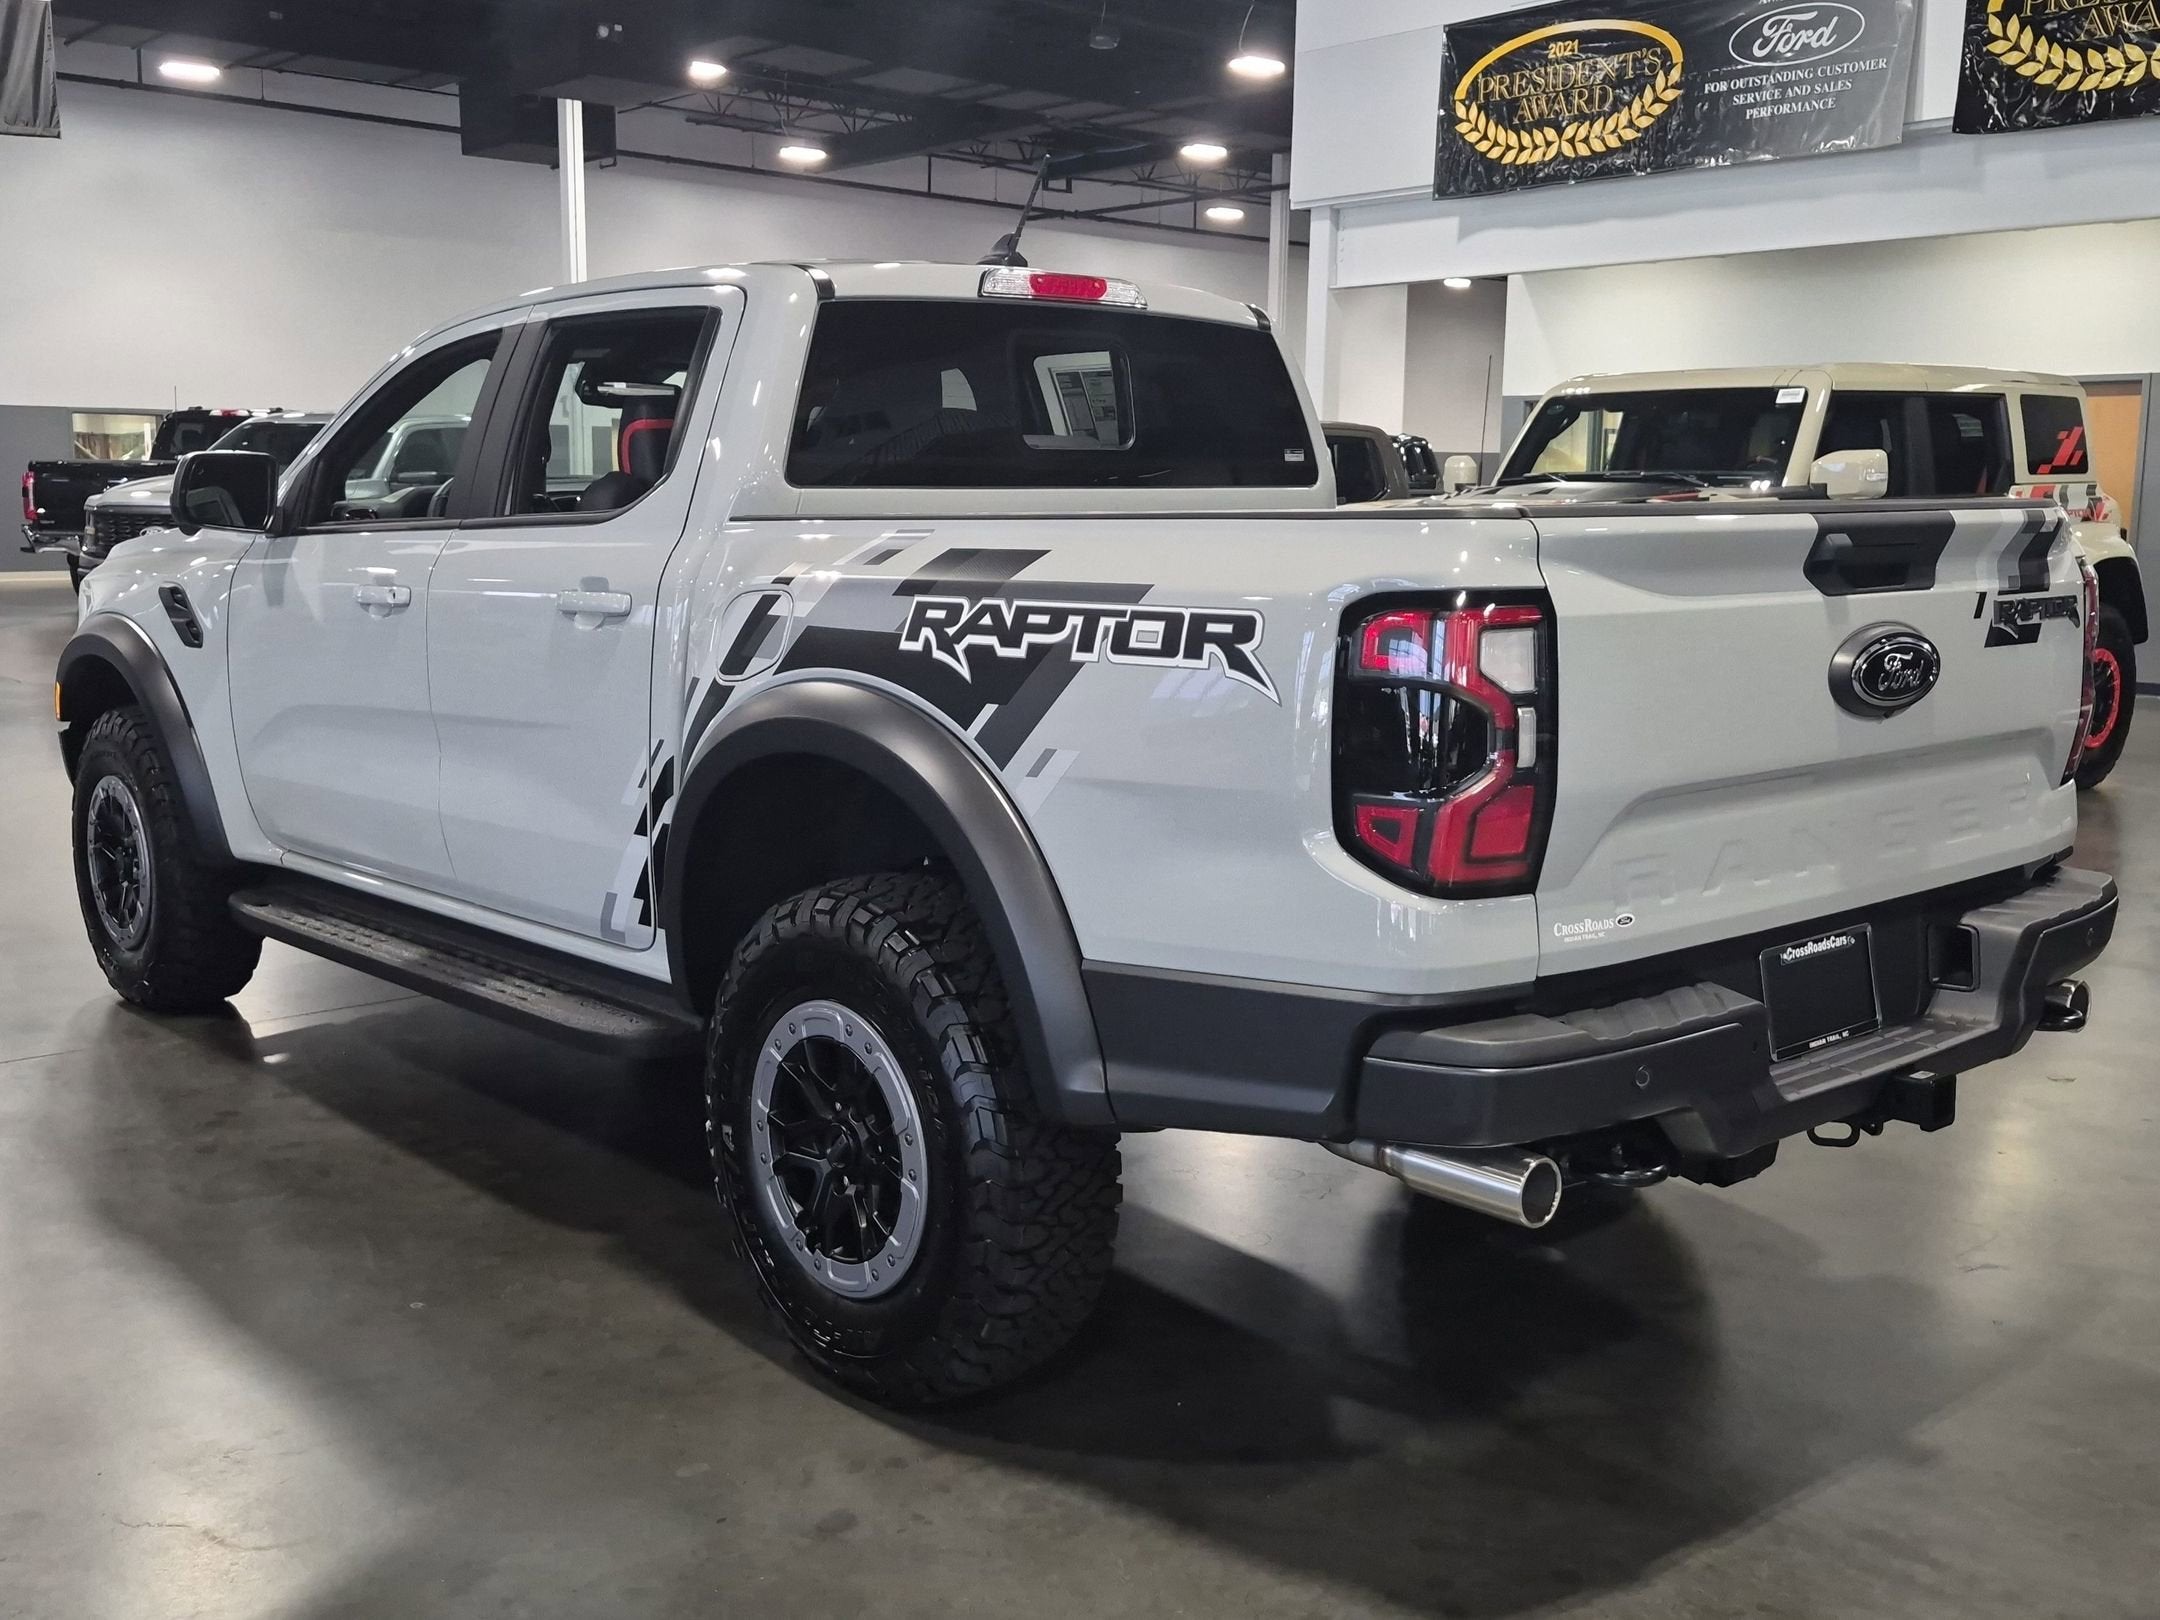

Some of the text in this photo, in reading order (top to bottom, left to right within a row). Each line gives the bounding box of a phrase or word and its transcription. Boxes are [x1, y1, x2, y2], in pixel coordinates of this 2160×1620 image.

[1547, 39, 1580, 58] 2021
[1752, 10, 1839, 58] Ford
[1477, 47, 1662, 104] PRESIDENT'S
[1704, 57, 1888, 95] FOR OUTSTANDING CUSTOMER
[1732, 78, 1853, 106] SERVICE AND SALES
[1512, 84, 1614, 125] AWARD
[1745, 97, 1837, 120] PERFORMANCE
[899, 594, 1282, 708] RAPTOR
[1878, 651, 1924, 692] Ford
